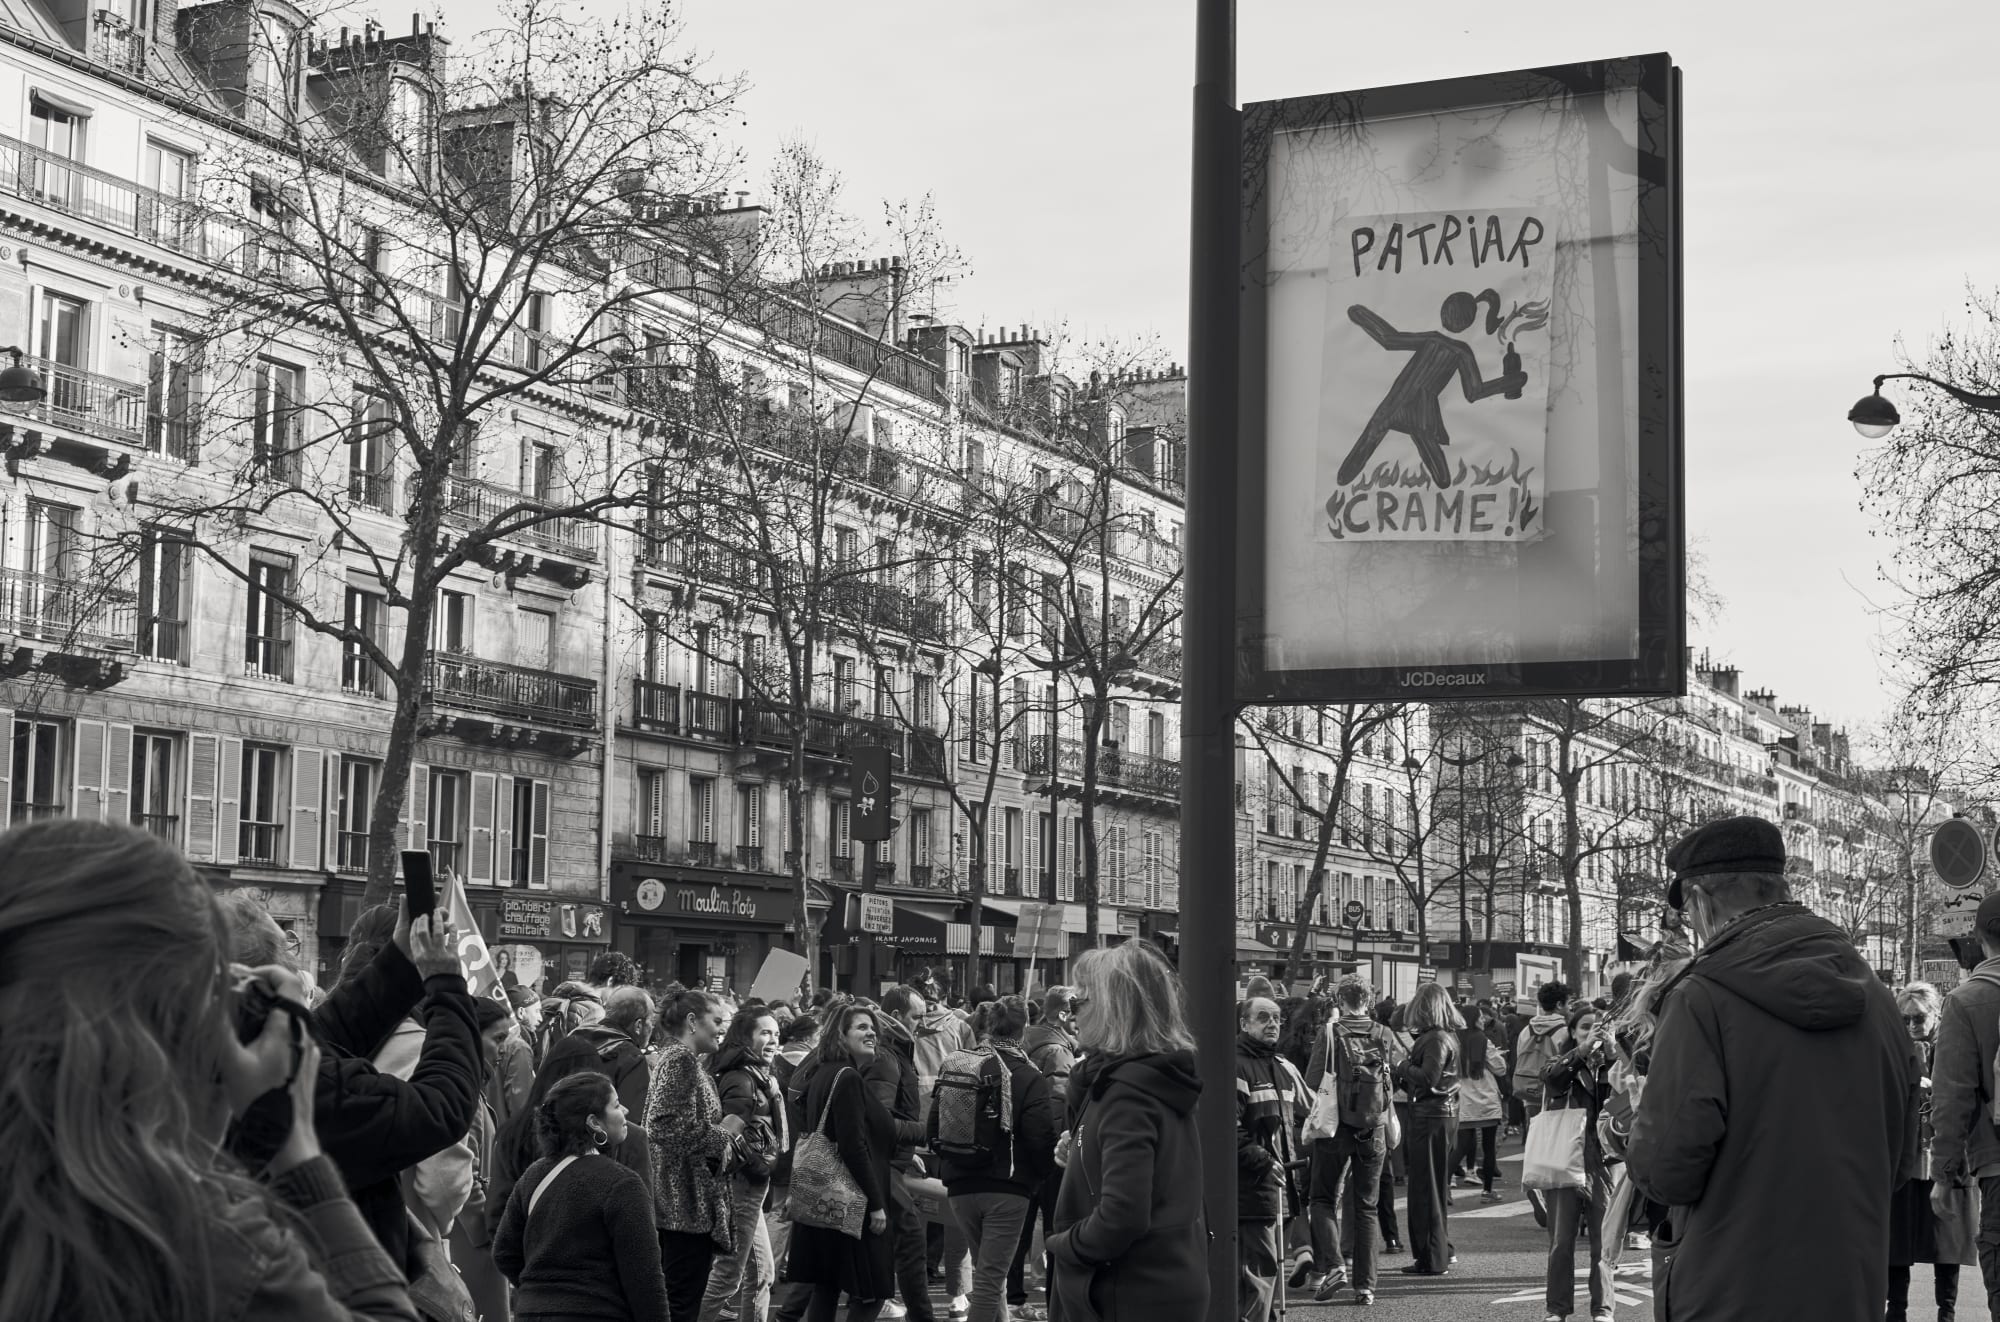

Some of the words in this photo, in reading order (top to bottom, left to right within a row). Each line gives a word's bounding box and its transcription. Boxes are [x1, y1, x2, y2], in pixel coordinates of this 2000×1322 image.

[1343, 487, 1519, 537] CRAME!
[1401, 672, 1486, 687] JCDecaux
[677, 886, 729, 914] Moulin
[732, 889, 756, 919] Roty
[1348, 905, 1361, 913] BUS
[505, 911, 551, 927] chauffage
[504, 924, 550, 936] sanitaire
[900, 936, 937, 944] JAPONAIS
